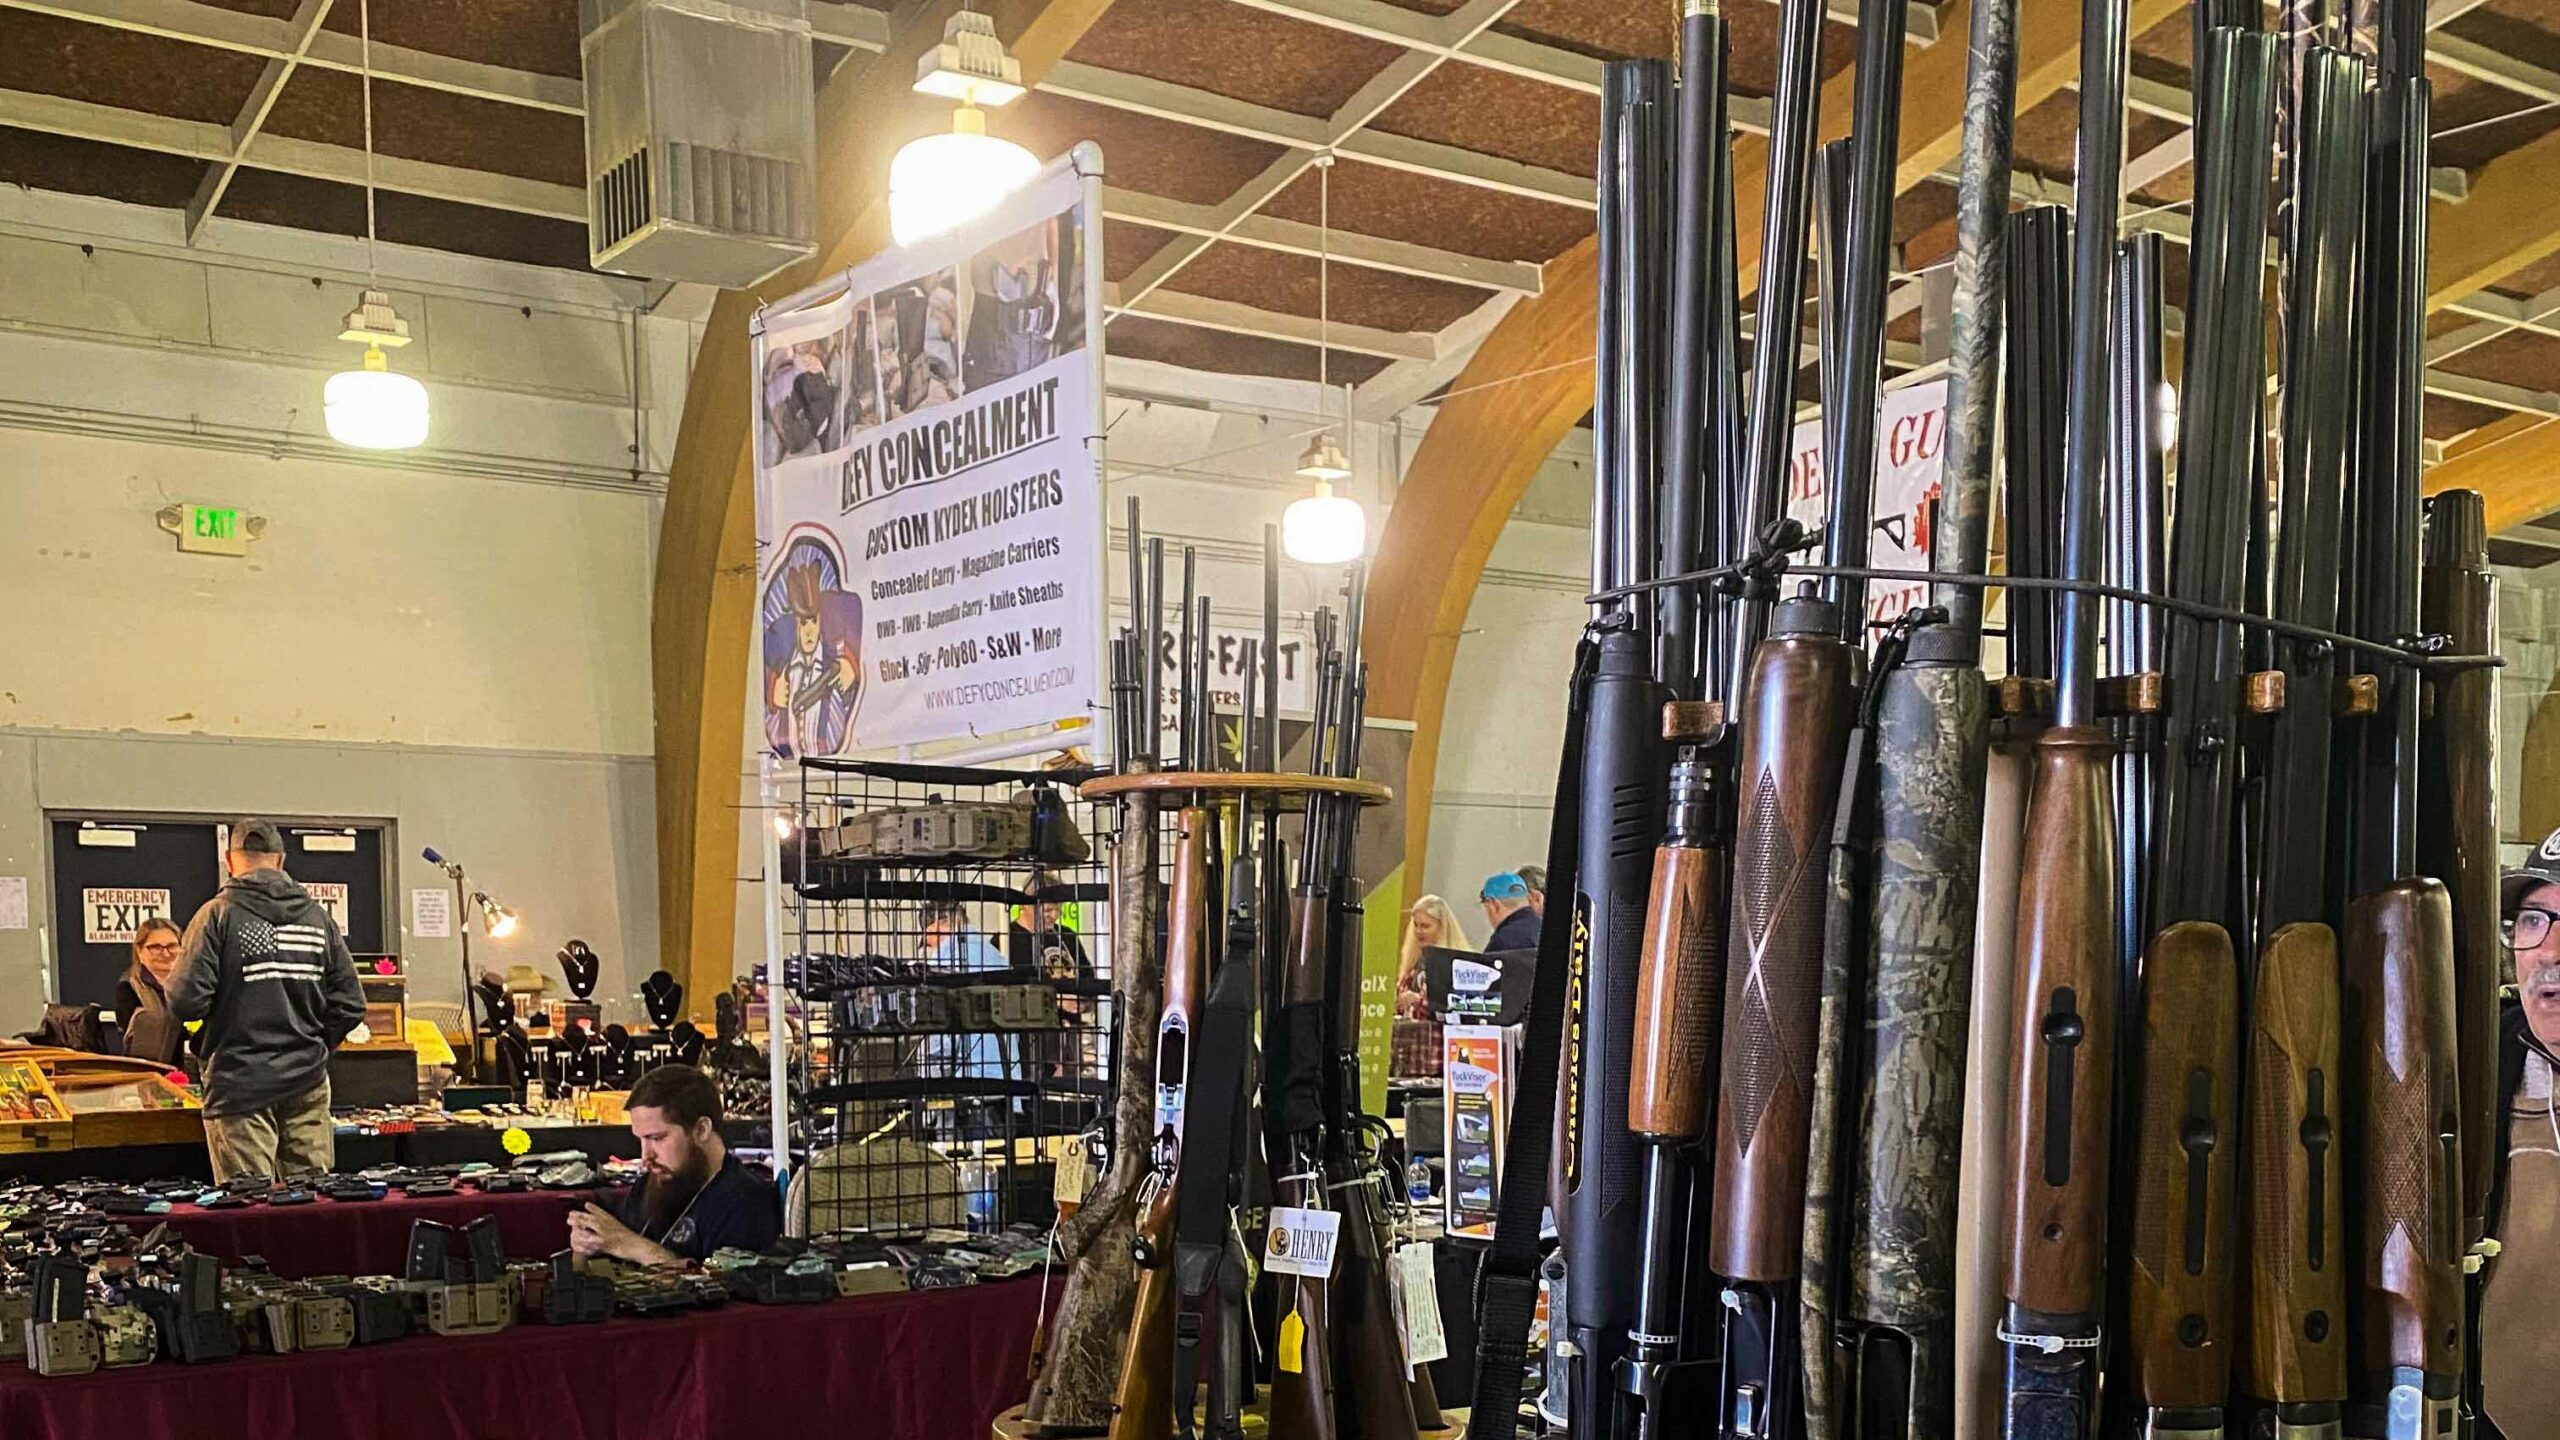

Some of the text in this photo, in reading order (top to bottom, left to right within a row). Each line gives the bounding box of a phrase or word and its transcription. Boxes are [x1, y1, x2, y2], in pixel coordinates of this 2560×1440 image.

[878, 376, 1059, 491] CONCEALMENT
[195, 507, 237, 539] EXIT
[866, 468, 1063, 560] CUSTOM KYDEX HOLSTERS
[871, 567, 930, 600] Concealed
[931, 564, 956, 586] Carry
[962, 551, 1006, 579] Magazine
[1007, 535, 1060, 565] Carriers
[876, 620, 896, 639] OWB
[902, 614, 922, 635] IWB
[927, 605, 961, 629] Appendix
[961, 598, 983, 619] Carry
[989, 590, 1017, 612] Knife
[1019, 581, 1064, 606] Sheaths
[879, 656, 910, 683] Glock
[916, 652, 930, 676] Sig
[936, 638, 977, 671] Poly80
[986, 631, 1022, 660] S&W
[1032, 626, 1062, 653] More
[925, 664, 1075, 709] WWW.DEFYCONCEALMENT.COM
[87, 890, 166, 904] EMERGENCY
[306, 884, 345, 898] GENCY
[88, 932, 117, 941] ALARM
[96, 904, 160, 931] EXIT
[1290, 1228, 1334, 1261] HENRY
